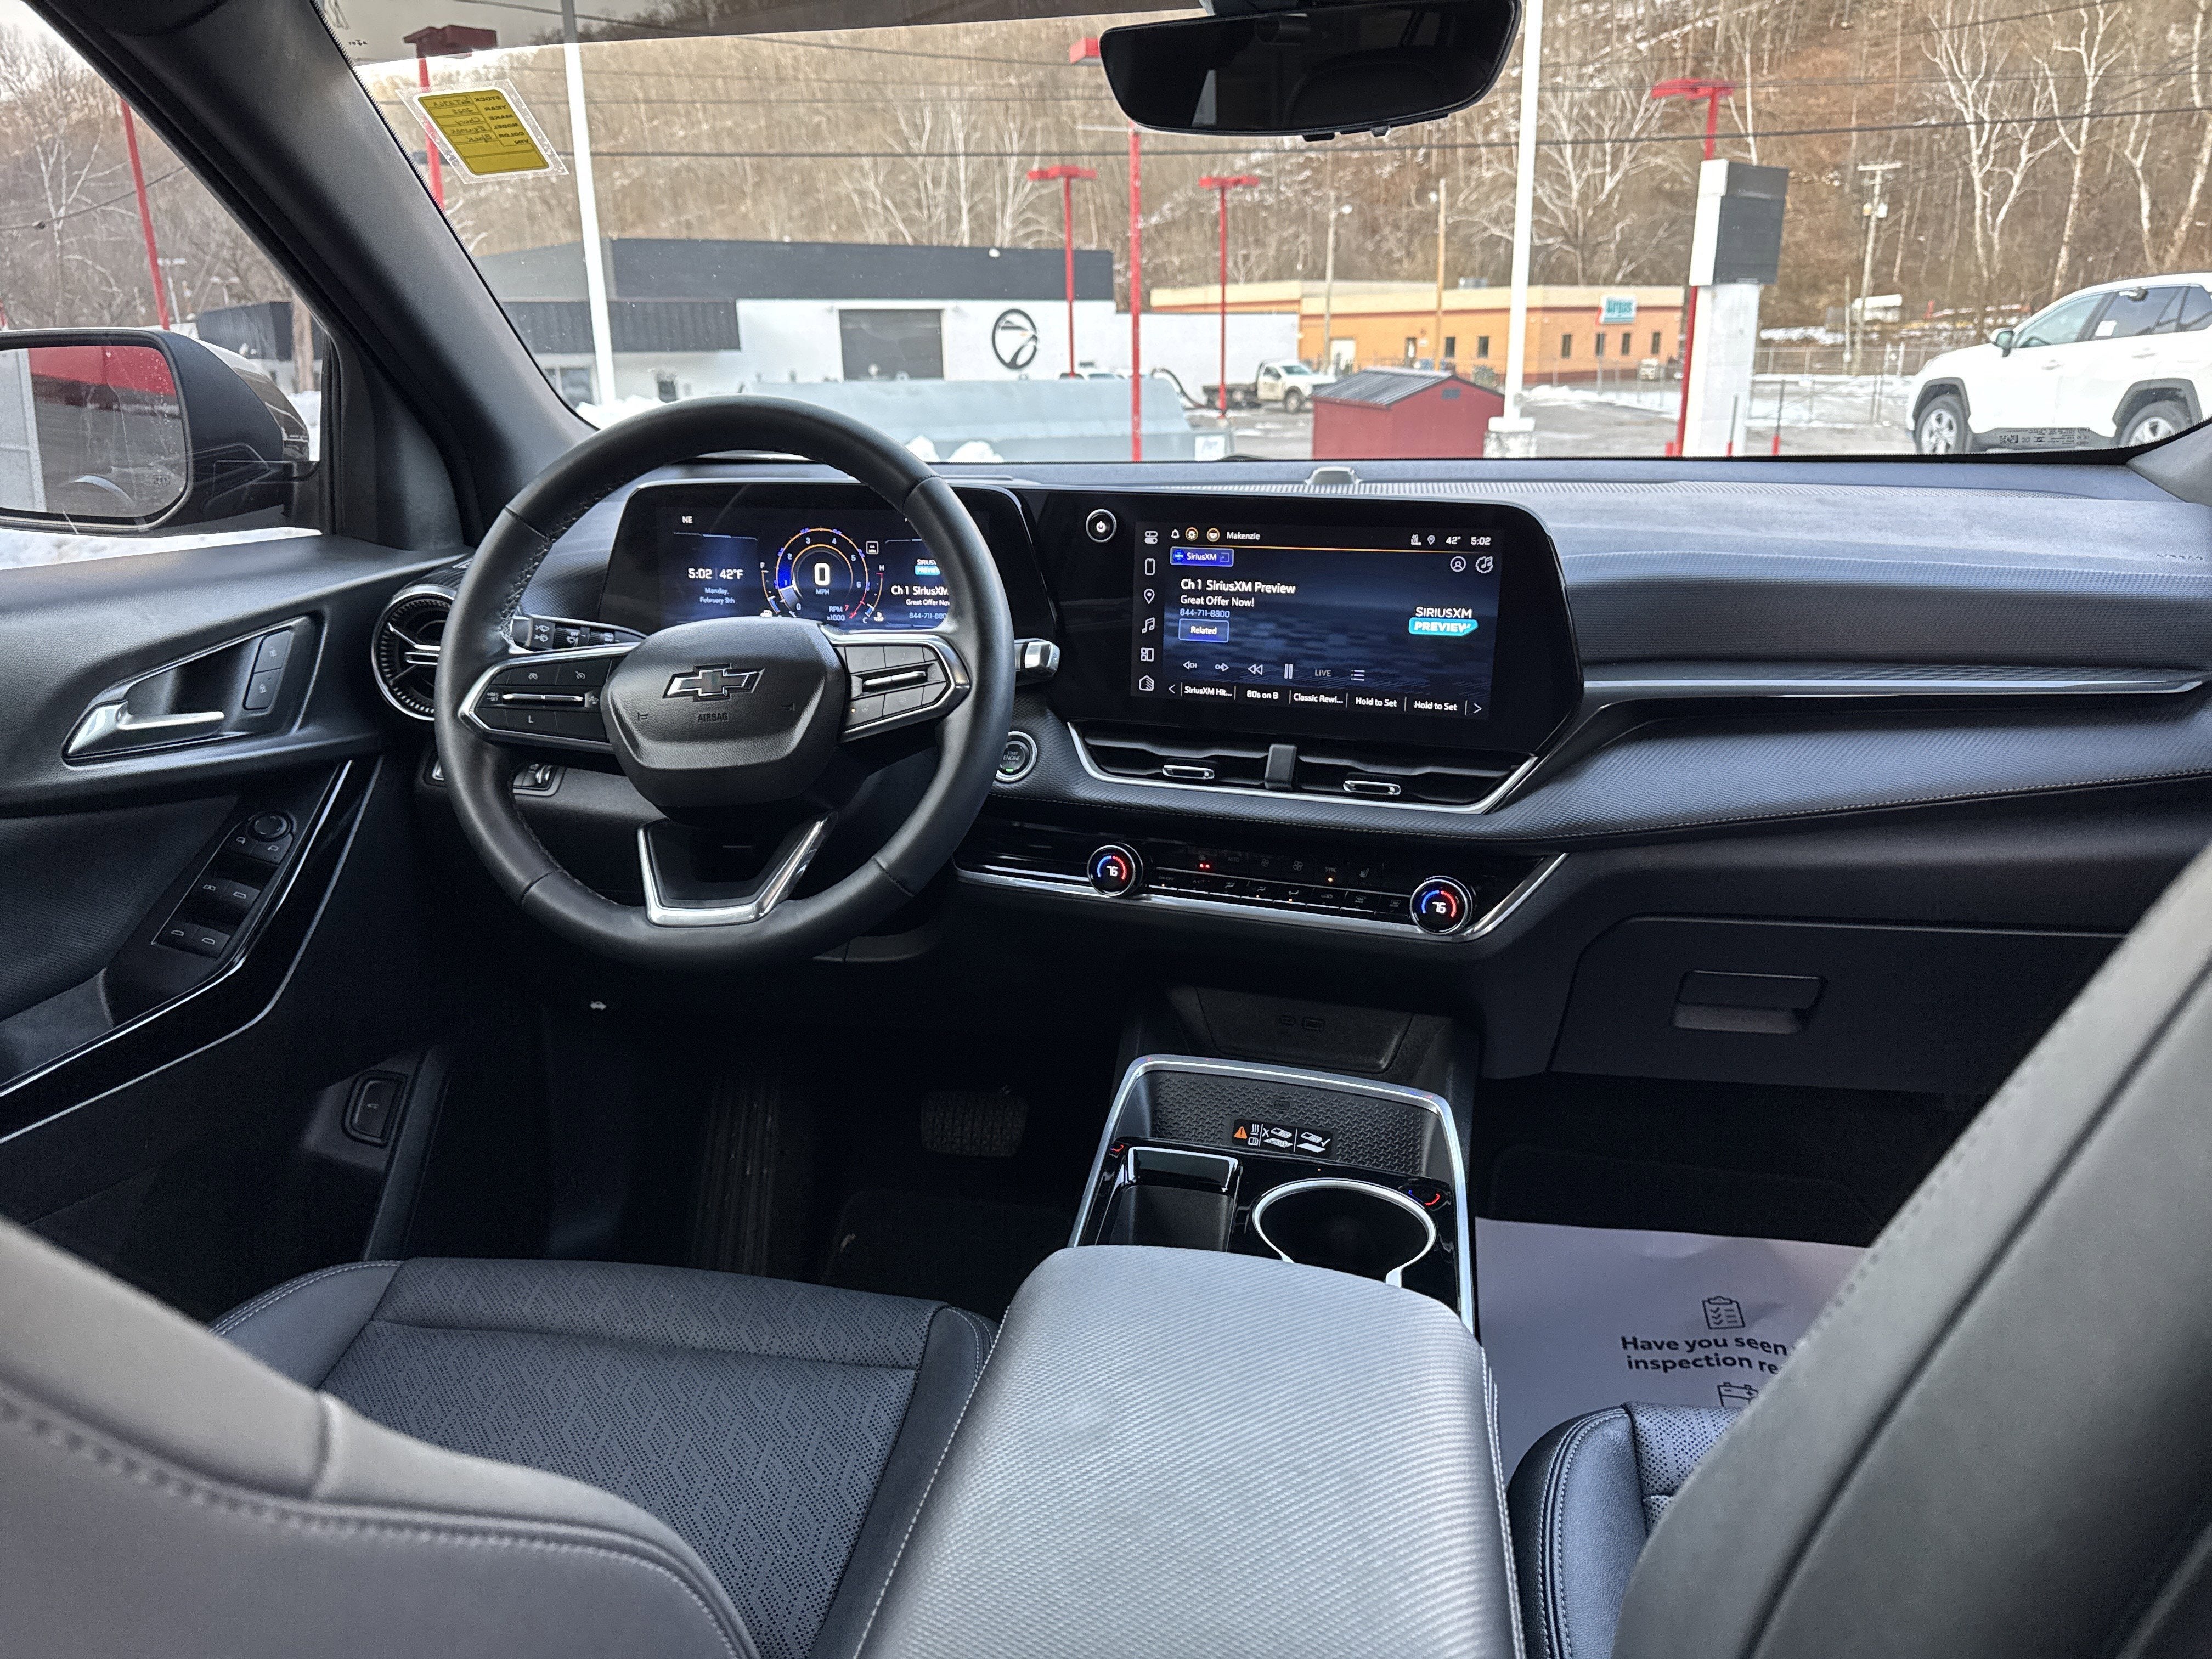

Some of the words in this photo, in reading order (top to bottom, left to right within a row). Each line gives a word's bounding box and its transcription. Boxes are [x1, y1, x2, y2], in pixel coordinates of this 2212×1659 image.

[1227, 531, 1260, 540] Makenzie
[1471, 537, 1491, 545] 5:02
[1187, 552, 1216, 561] SiriusXM
[688, 568, 712, 579] 5:02
[719, 569, 743, 579] 42°F
[814, 562, 831, 586] 0
[891, 585, 903, 595] Ch
[905, 585, 909, 595] 1
[1181, 578, 1195, 590] Ch
[1197, 579, 1201, 590] 1
[1206, 579, 1251, 592] SiriusXM
[1254, 582, 1296, 594] Preview
[699, 596, 724, 605] February
[1180, 595, 1205, 605] Great
[1206, 596, 1229, 606] Offer
[1231, 597, 1254, 607] Now!
[1180, 608, 1230, 618] 844-711-8800
[1415, 606, 1472, 618] SIRIUSXM
[1190, 626, 1217, 635] Related
[1414, 621, 1471, 633] PREVIEW
[1184, 686, 1215, 695] SiriusXM
[1246, 690, 1261, 698] 80s
[1273, 691, 1278, 699] 8
[1293, 693, 1318, 702] Classic
[1355, 697, 1373, 706] Hold
[1384, 699, 1397, 707] Set
[1414, 701, 1433, 709] Hold
[1444, 703, 1458, 711] Set
[698, 712, 729, 723] AIRBAG
[1107, 866, 1118, 877] 76
[1432, 901, 1446, 913] 76
[1621, 1336, 1679, 1352] Have
[1685, 1335, 1728, 1353] you
[1734, 1337, 1787, 1356] seen
[1627, 1353, 1753, 1373] inspection
